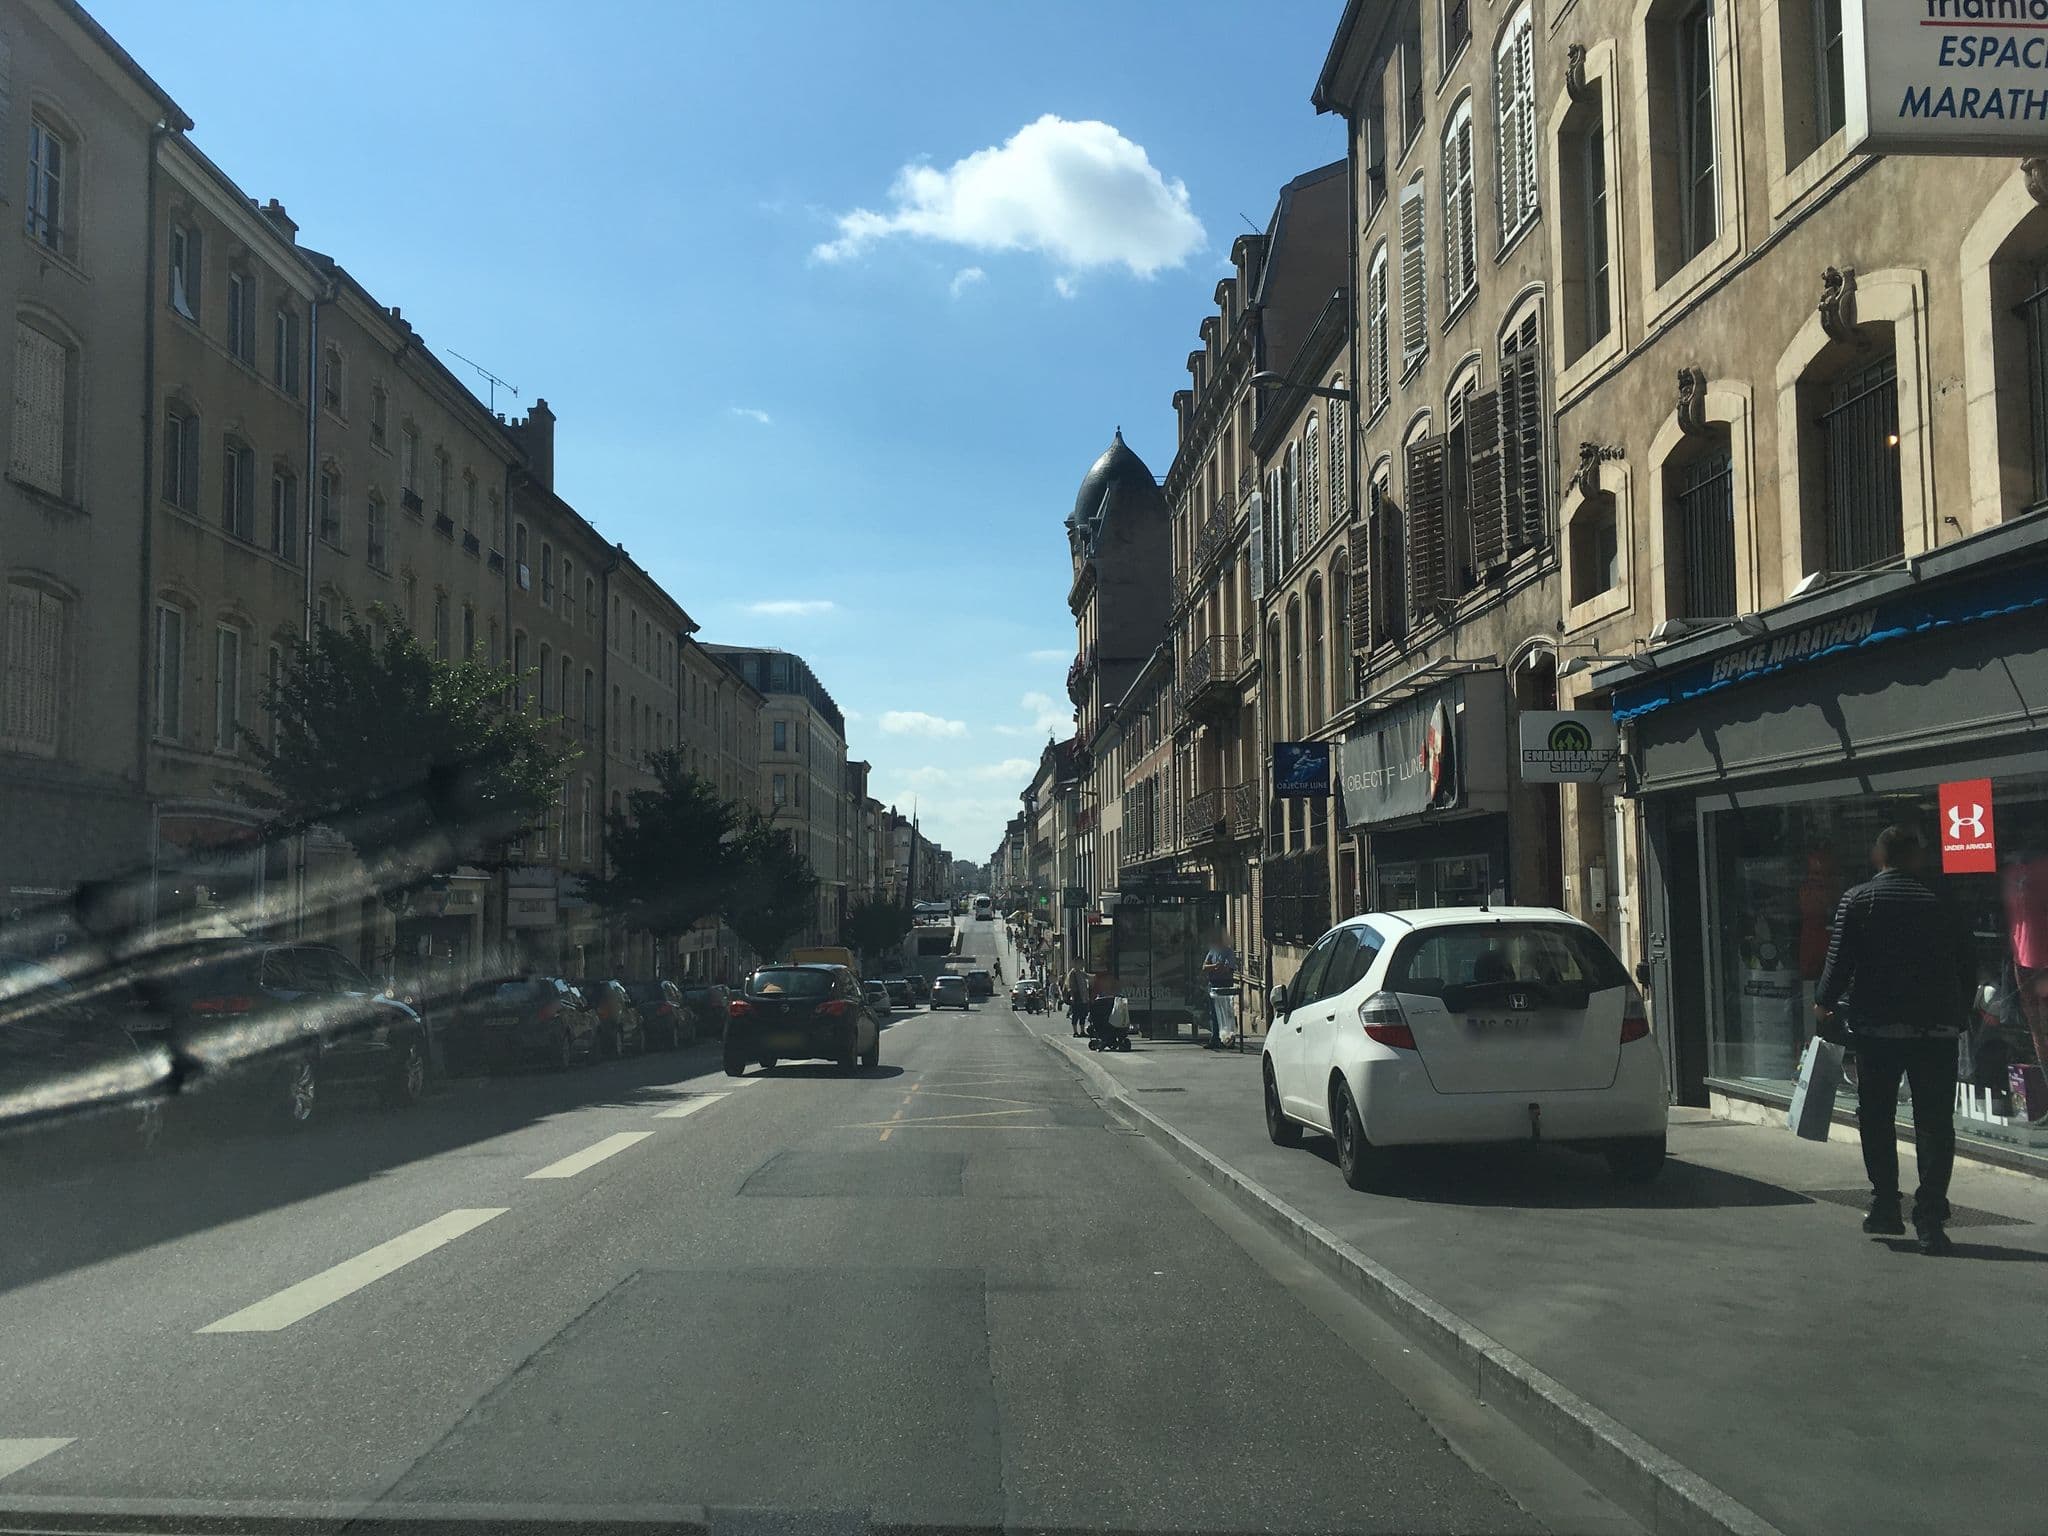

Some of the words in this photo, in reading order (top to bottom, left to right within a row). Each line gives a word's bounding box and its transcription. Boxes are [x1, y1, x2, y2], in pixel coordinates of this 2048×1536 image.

[1939, 35, 2048, 69] ESPAC
[1899, 86, 2048, 120] MARATH
[1711, 644, 1767, 682] ESPACE
[1768, 608, 1879, 664] MARATHON
[1523, 750, 1617, 762] ENDURANCE
[1550, 761, 1592, 773] SHOP
[1276, 781, 1308, 789] OBJECTIF
[1310, 781, 1328, 789] LUNE
[1954, 1081, 2009, 1127] ILL.
